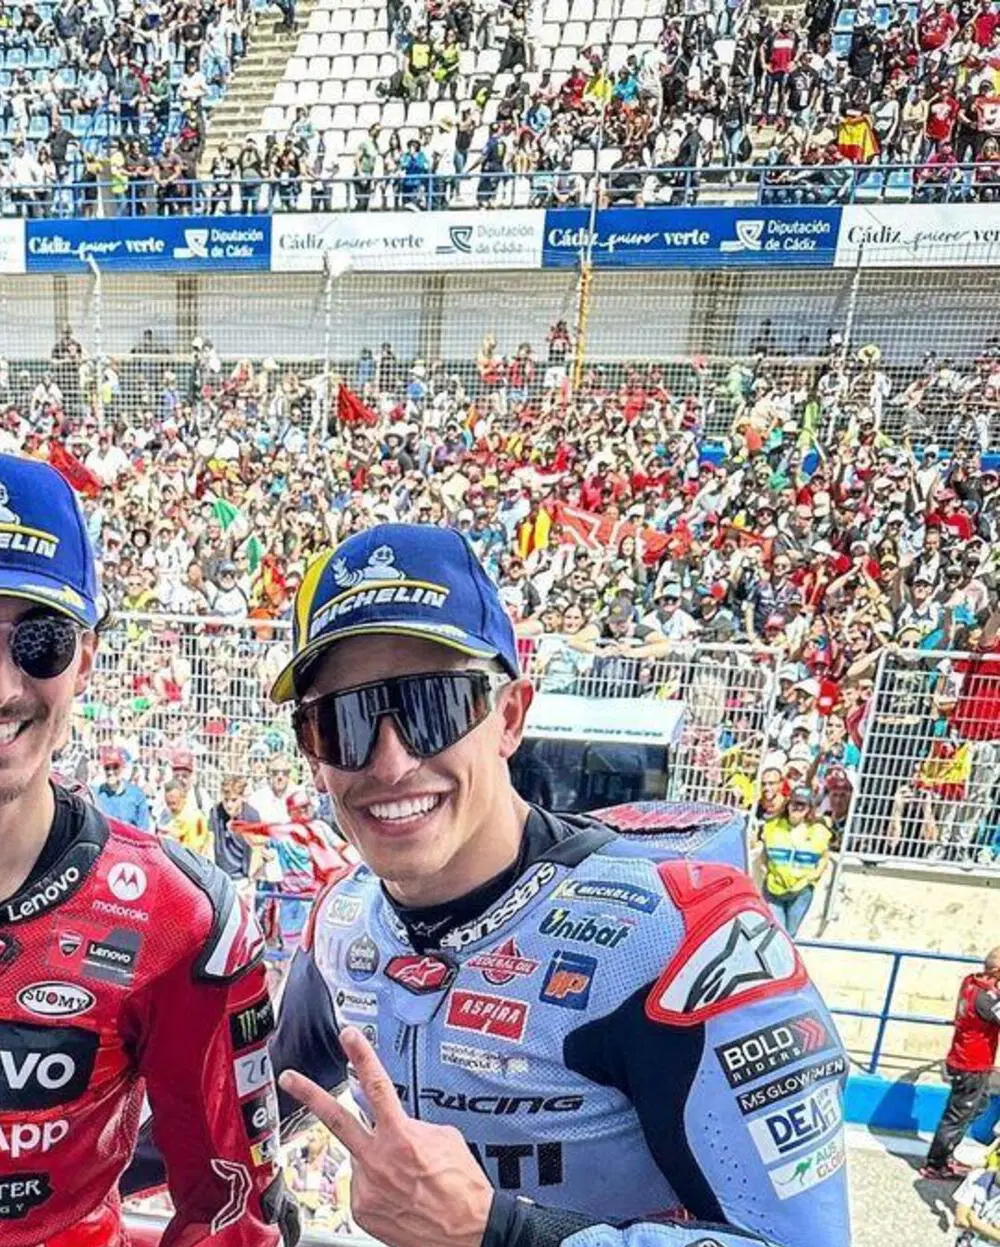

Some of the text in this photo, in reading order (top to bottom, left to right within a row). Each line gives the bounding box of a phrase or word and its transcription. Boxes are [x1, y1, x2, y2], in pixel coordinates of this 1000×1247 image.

[211, 228, 264, 243] Diputación
[548, 226, 598, 248] Cádiz
[664, 229, 710, 246] verte
[768, 219, 831, 236] Diputación
[848, 225, 901, 245] Cádiz
[29, 234, 71, 254] Cádiz
[125, 236, 164, 253] verte
[211, 244, 253, 257] de Cádiz
[765, 238, 816, 251] de Cádiz
[310, 587, 449, 640] MICHELIN
[8, 866, 80, 922] Lenovo
[92, 899, 150, 921] motorola
[538, 908, 630, 949] Unibat
[90, 943, 131, 964] Lenovo
[25, 988, 89, 1011] SUOMY
[459, 998, 521, 1025] ASPIRA
[723, 1027, 795, 1071] BOLD
[419, 1087, 585, 1115] RACING
[742, 1091, 766, 1111] MS
